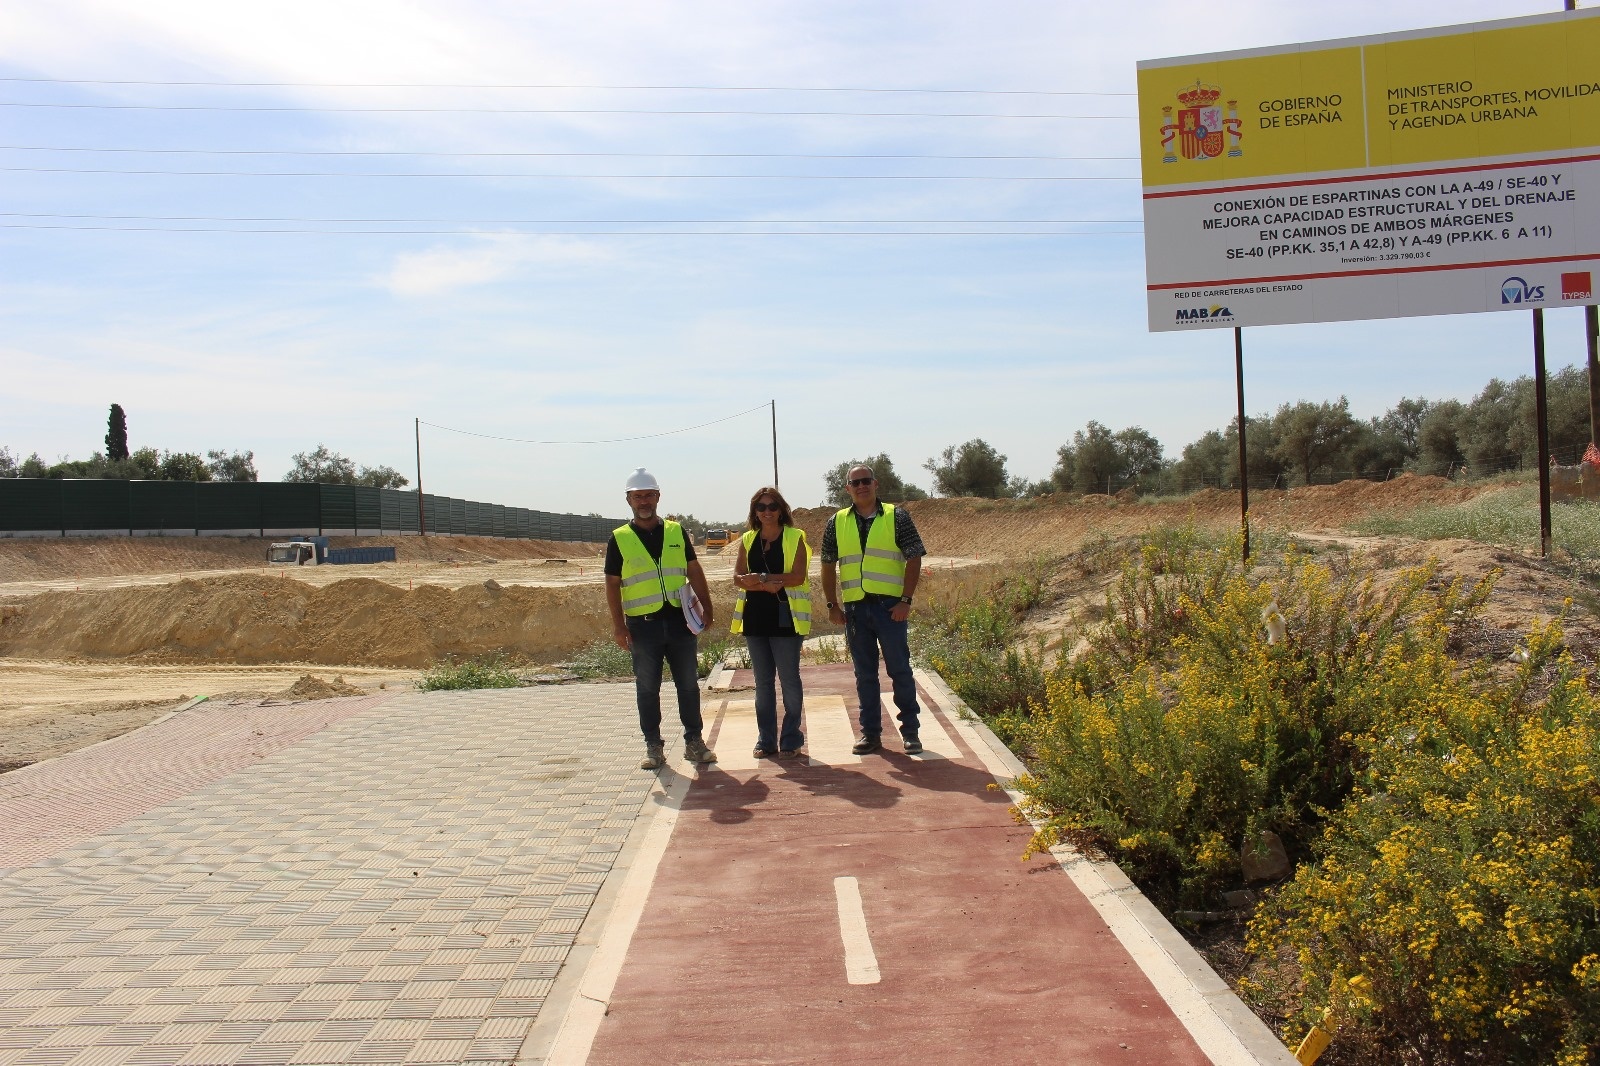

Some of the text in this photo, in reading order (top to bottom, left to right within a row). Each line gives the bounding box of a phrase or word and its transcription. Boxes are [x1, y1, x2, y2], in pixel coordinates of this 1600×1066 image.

[1387, 80, 1473, 100] MINISTERIO
[1259, 94, 1342, 113] GOBIERNO
[1388, 103, 1408, 115] DE
[1411, 91, 1521, 112] TRANSPORTES,
[1260, 109, 1343, 129] DE ESPAÑA
[1389, 105, 1538, 130] Y AGENDA URBANA
[1214, 196, 1285, 213] CONEXIÓN
[1290, 195, 1308, 207] DE
[1312, 187, 1401, 204] ESPARTINAS
[1405, 184, 1436, 198] CON
[1440, 183, 1459, 195] LA
[1463, 180, 1494, 193] A-49
[1506, 175, 1547, 189] SE-40
[1551, 174, 1561, 185] Y
[1203, 189, 1576, 230] MEJORA CAPACIDAD ESTRUCTURAL Y DEL DRENAJE
[1260, 211, 1514, 241] EN CAMINOS DE AMBOS MÁRGENES
[1226, 225, 1552, 260] SE-40 (PP.KK. 35,1 A 42,8) Y A-49 (PP.KK. 6 A 11)
[1341, 255, 1377, 263] Inversión:
[1191, 290, 1202, 298] DE
[1203, 287, 1254, 297] CARRETERAS
[1256, 286, 1271, 294] DEL
[1273, 284, 1303, 292] ESTADO
[1562, 291, 1592, 300] TYPSA
[1175, 308, 1209, 320] MAB
